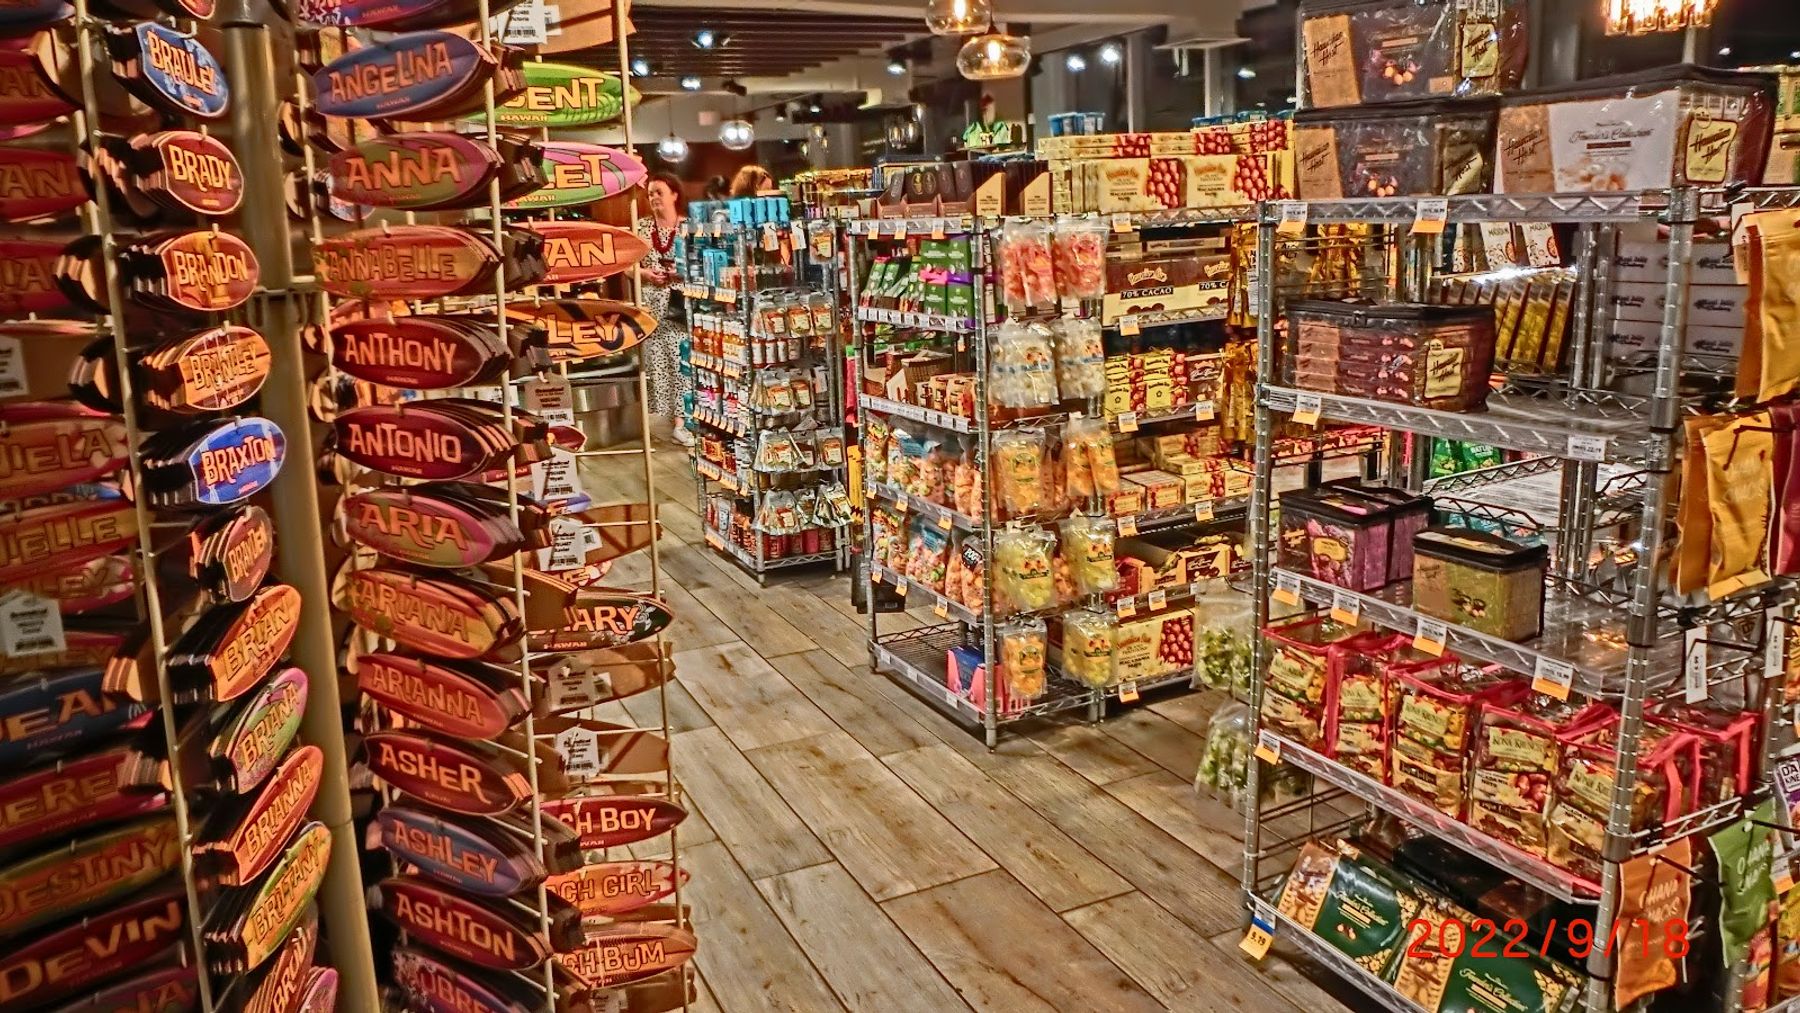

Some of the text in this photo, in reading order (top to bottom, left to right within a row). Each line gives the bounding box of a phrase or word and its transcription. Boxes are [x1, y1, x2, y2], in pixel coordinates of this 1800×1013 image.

[146, 30, 217, 95] BRADLEY
[331, 42, 452, 102] ANGELINA
[500, 114, 548, 122] HAWAII
[168, 144, 233, 192] BRADY
[347, 148, 462, 191] ANNA
[541, 153, 611, 191] ET
[173, 250, 248, 292] BRANDON
[328, 245, 457, 282] ANNABELLE
[1122, 287, 1172, 299] 70% CACAO
[344, 334, 456, 374] ANTHONY
[202, 432, 277, 487] BRAXTON
[349, 424, 462, 464] ANTONIO
[360, 504, 467, 550] ARIA
[360, 583, 470, 642] ARIANA
[225, 595, 293, 682] BRIAN
[372, 664, 483, 726] ARIANNA
[240, 680, 299, 772] BRIANA
[380, 743, 491, 804] ASHER
[1781, 765, 1798, 777] DA
[245, 762, 316, 857] BRIANNA
[600, 807, 656, 834] BOY
[395, 820, 498, 884] ASHLEY
[0, 834, 170, 920] DESTINY
[253, 840, 321, 945] BRITTANY
[603, 870, 660, 898] GIRL
[2, 901, 182, 1000] DEVIN
[396, 892, 515, 961] ASHTON
[600, 941, 666, 972] BUM
[418, 969, 497, 1013] UBRE
